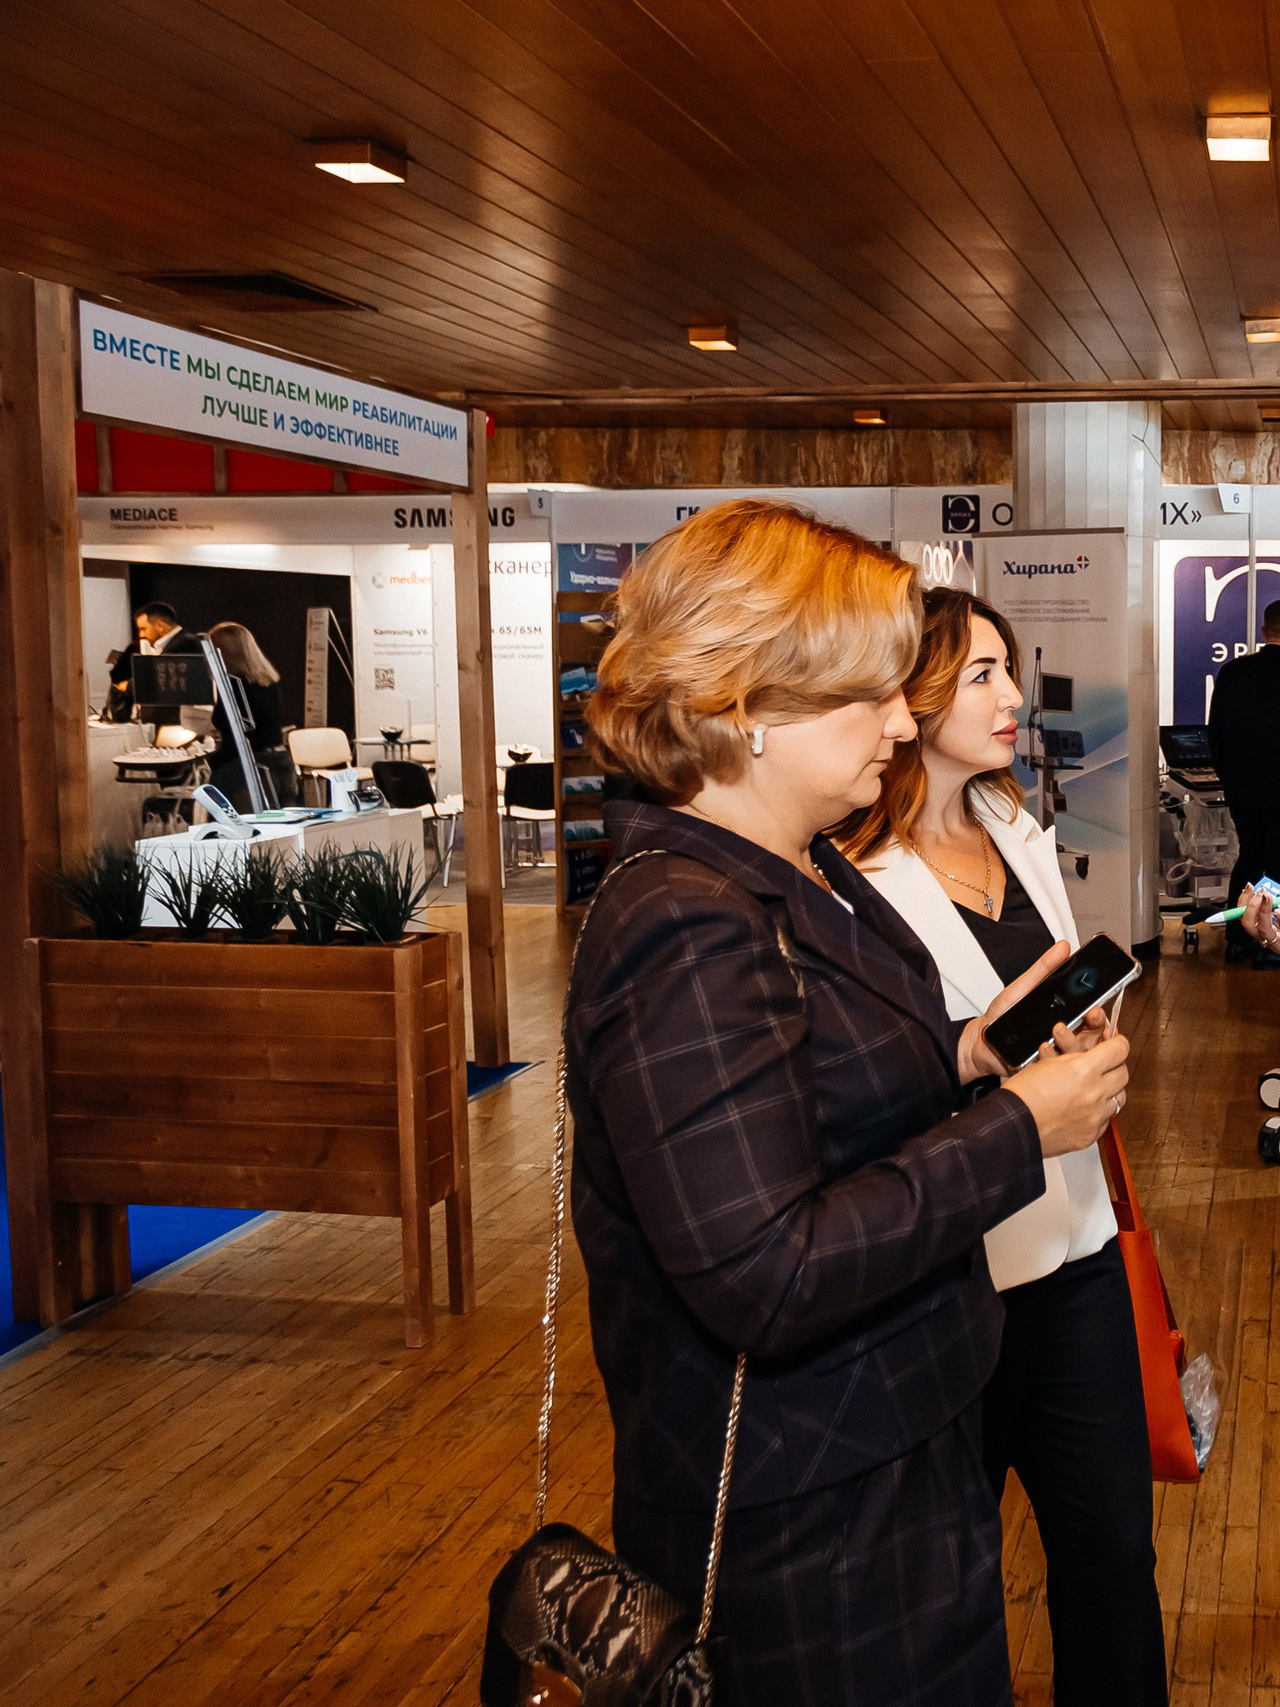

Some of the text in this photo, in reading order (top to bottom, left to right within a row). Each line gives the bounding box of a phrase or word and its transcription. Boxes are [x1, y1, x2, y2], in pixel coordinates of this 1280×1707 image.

[92, 328, 458, 442] ВМЕСТЕ МЫ СДЕЛАЕМ МИР РЕАБИЛИТАЦИИ
[202, 395, 400, 457] ЛУЧШЕ И ЭФФЕКТИВНЕЕ
[1233, 493, 1240, 504] 6
[110, 508, 178, 522] MEDIACE
[394, 507, 515, 528] SAMNG
[1003, 560, 1077, 579] Хирана
